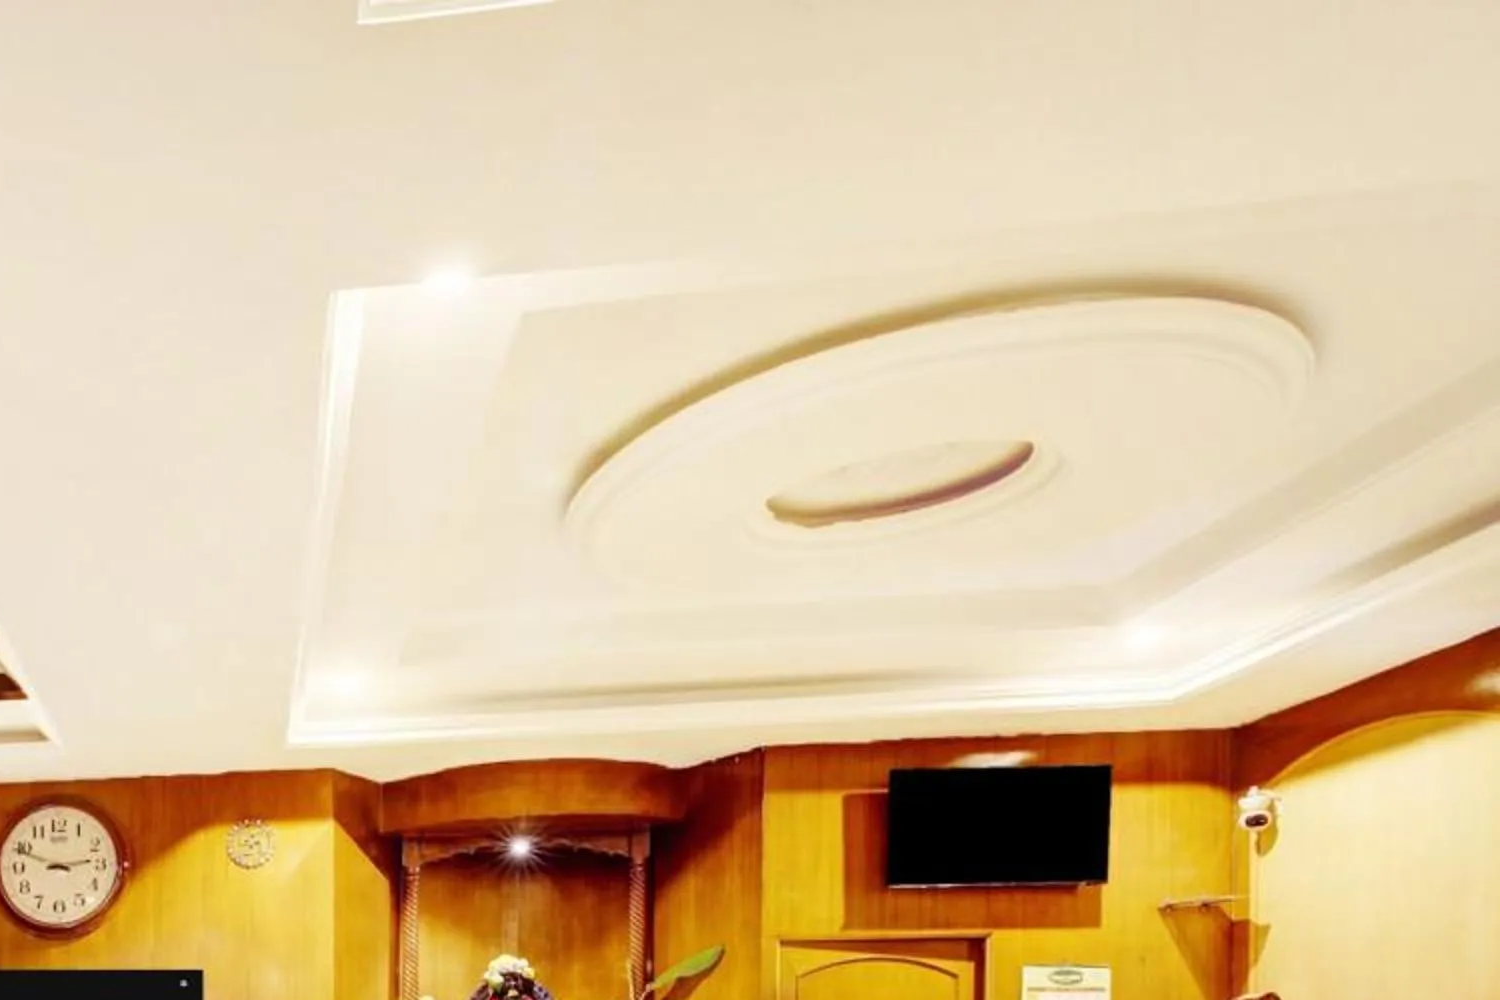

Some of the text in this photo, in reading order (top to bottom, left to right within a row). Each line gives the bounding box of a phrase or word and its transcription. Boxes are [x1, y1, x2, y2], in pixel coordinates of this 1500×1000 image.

[32, 824, 45, 839] 11
[51, 819, 68, 833] 12
[77, 823, 81, 837] 1
[89, 837, 101, 853] 2
[19, 880, 31, 894] 8
[33, 894, 44, 910] 7
